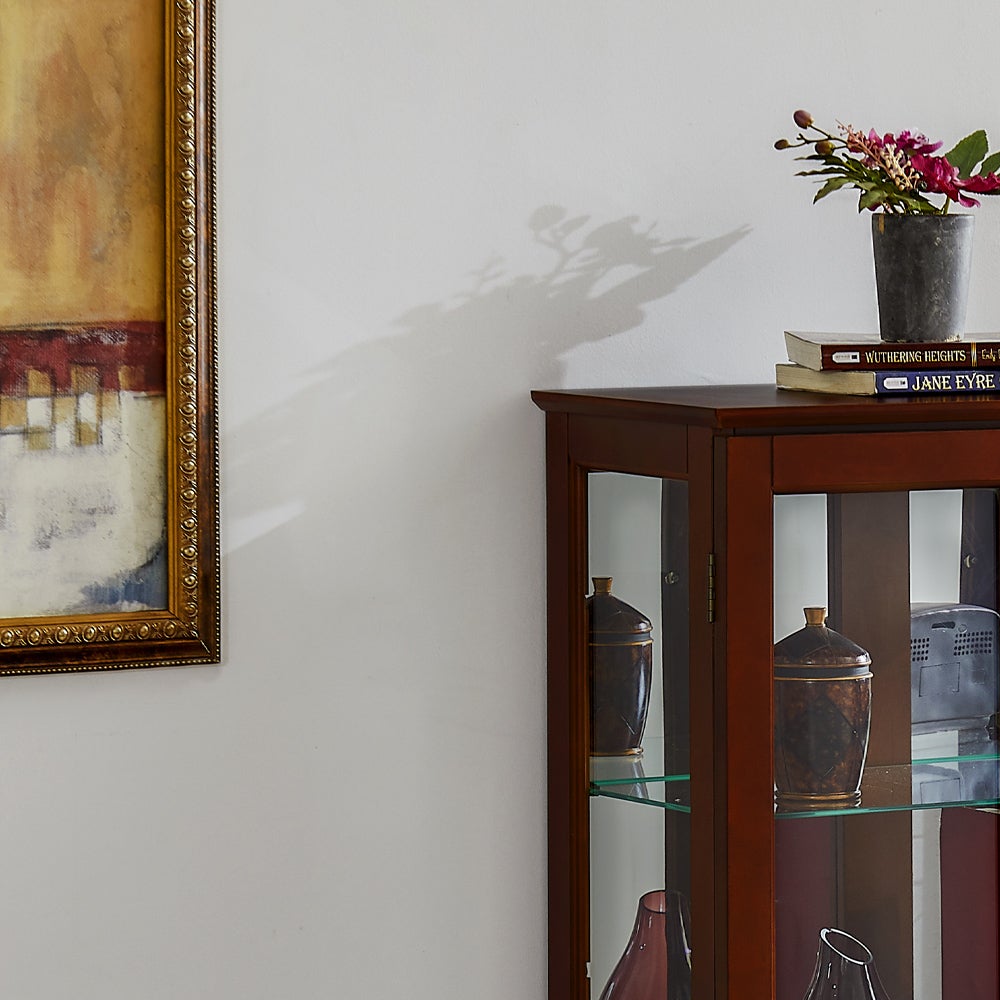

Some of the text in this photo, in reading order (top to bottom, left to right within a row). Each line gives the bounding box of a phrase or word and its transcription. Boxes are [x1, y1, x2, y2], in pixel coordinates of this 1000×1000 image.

[865, 350, 967, 363] WUTHERING HEIGHTS
[981, 348, 996, 362] Emily
[912, 372, 996, 391] JANE EYRE
